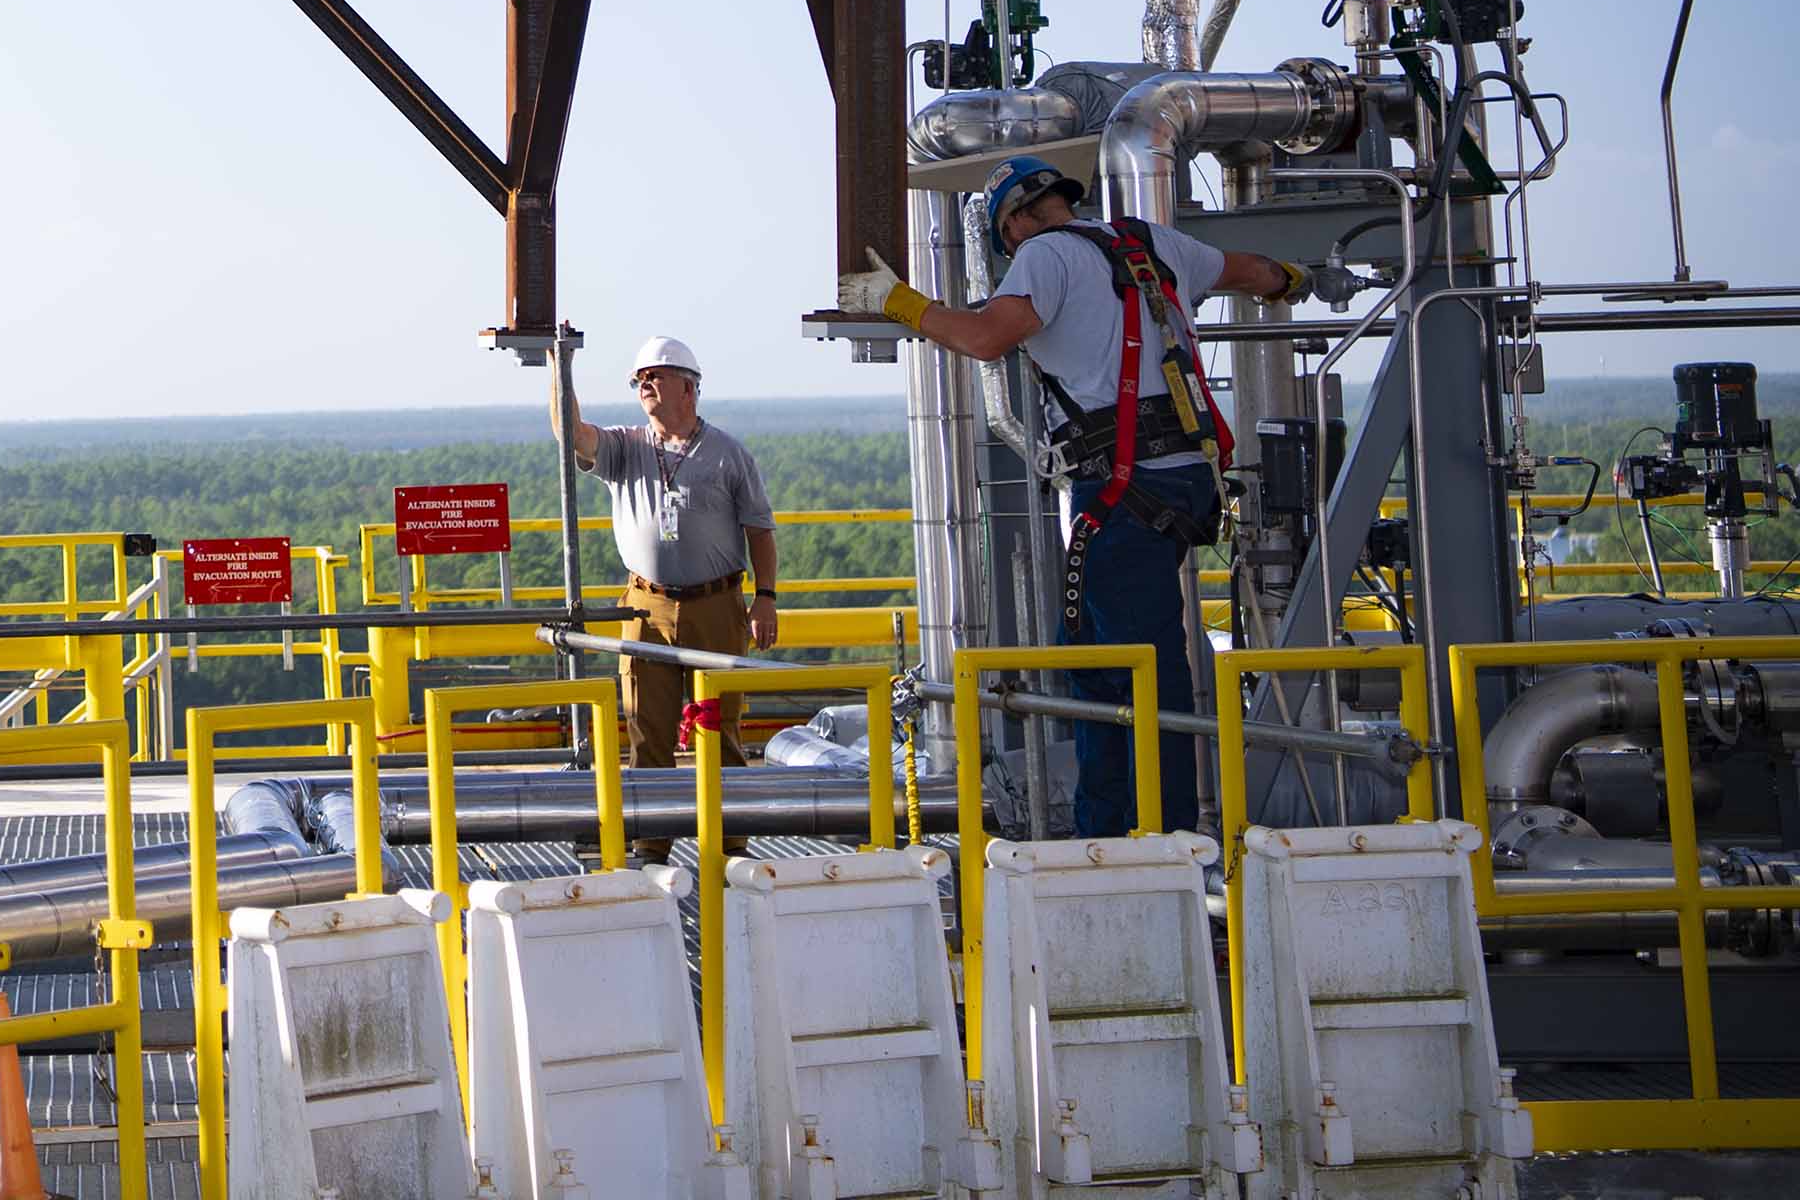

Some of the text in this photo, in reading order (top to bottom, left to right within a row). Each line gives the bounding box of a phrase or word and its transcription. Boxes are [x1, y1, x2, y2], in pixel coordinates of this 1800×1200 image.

[407, 499, 496, 510] ALTERNATE INSIDE
[441, 510, 463, 519] FIRE
[406, 519, 499, 530] EVACUATION ROUTE
[195, 551, 279, 562] ALTERNATE INSIDE
[227, 562, 248, 570] FIRE
[193, 570, 282, 581] EVACUATION ROUTE
